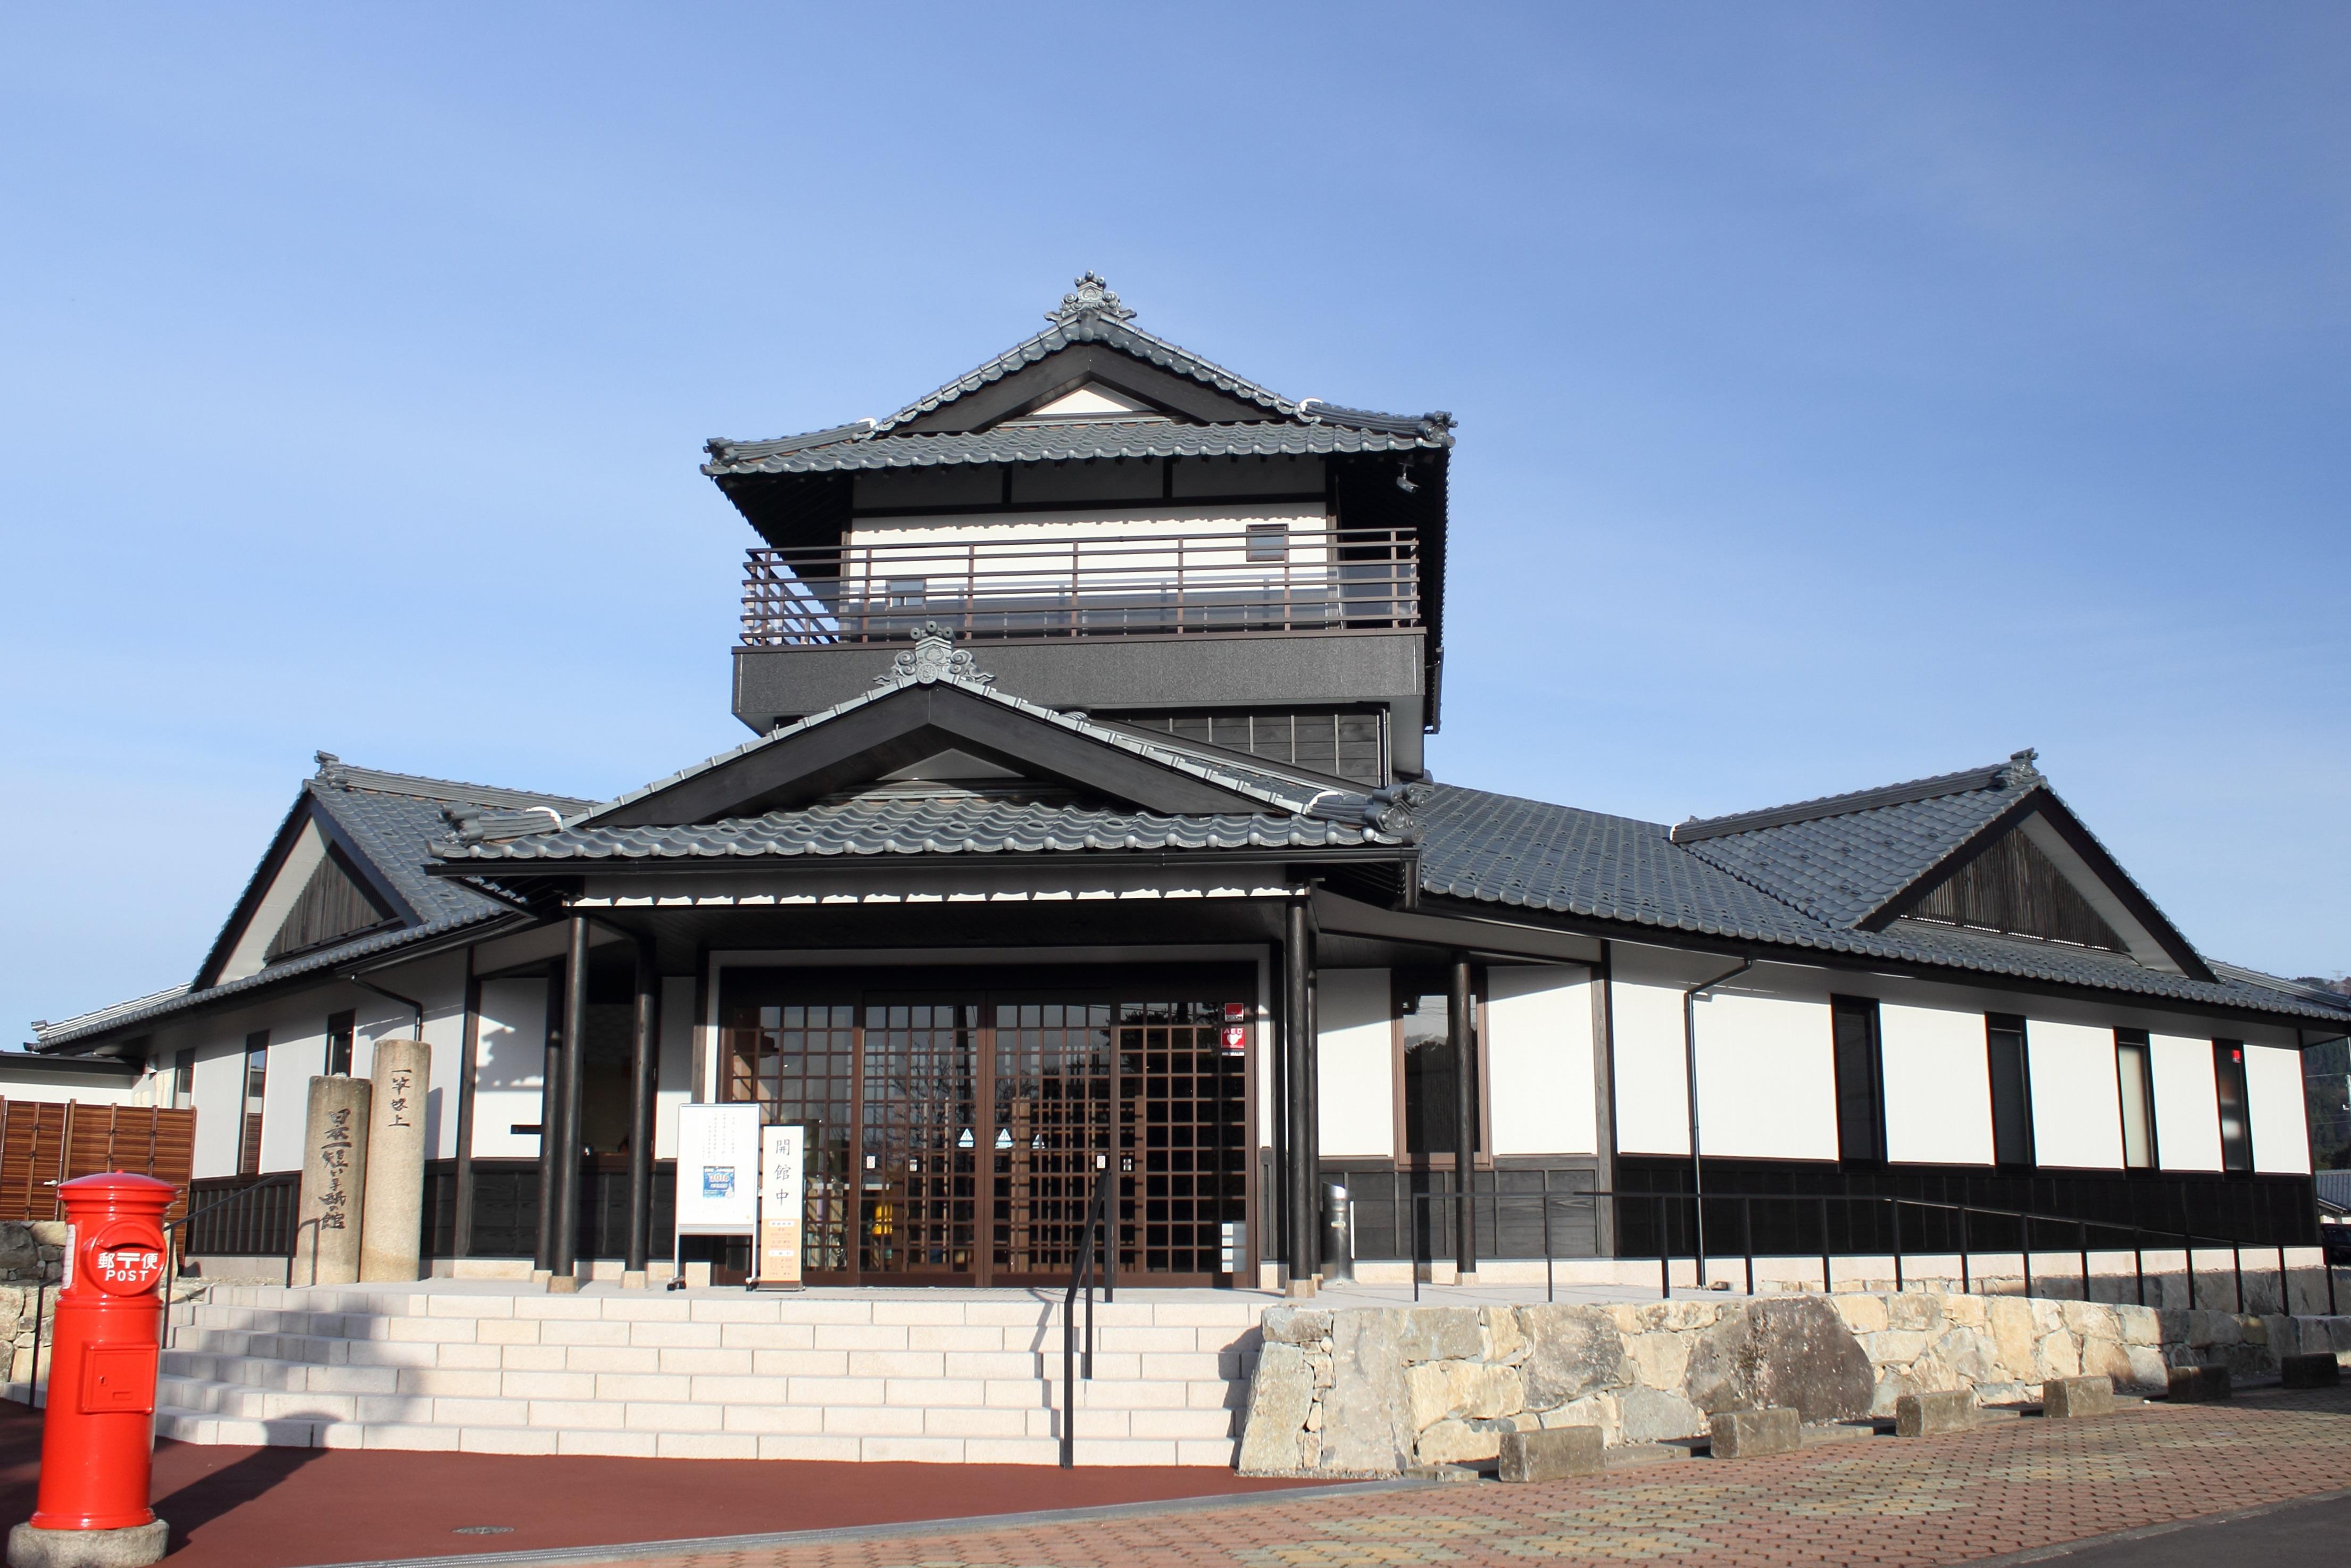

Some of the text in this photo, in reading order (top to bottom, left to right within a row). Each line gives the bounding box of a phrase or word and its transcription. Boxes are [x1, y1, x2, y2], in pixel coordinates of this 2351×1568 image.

[388, 1069, 412, 1127] 一筆啓上
[774, 1138, 792, 1206] 開館中
[105, 1270, 149, 1282] POST
